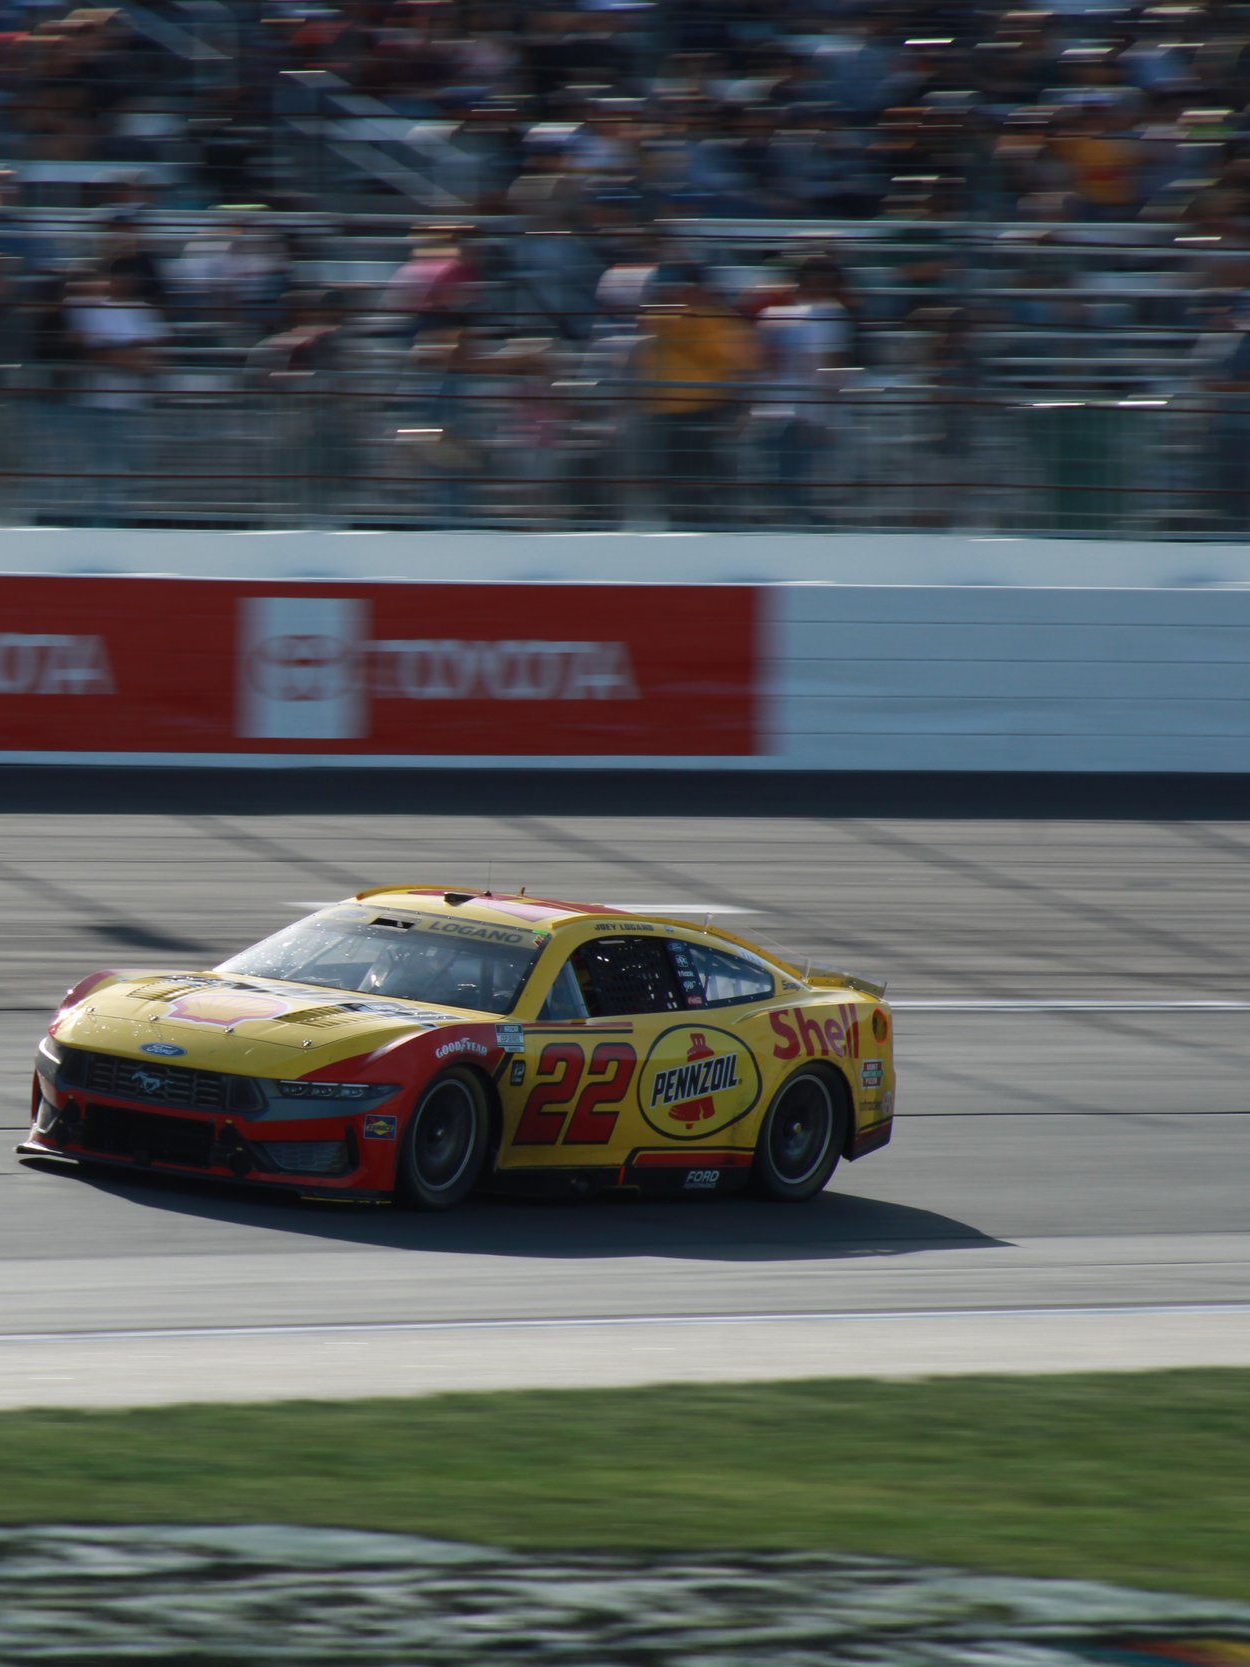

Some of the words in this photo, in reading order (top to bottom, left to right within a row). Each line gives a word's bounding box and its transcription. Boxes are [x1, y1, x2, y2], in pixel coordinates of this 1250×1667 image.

[428, 920, 524, 944] LOGANO
[594, 923, 616, 931] JOEY
[769, 1003, 859, 1060] Shell
[512, 1042, 637, 1144] 22
[651, 1053, 738, 1109] PENNZOIL
[686, 1170, 720, 1182] FORD
